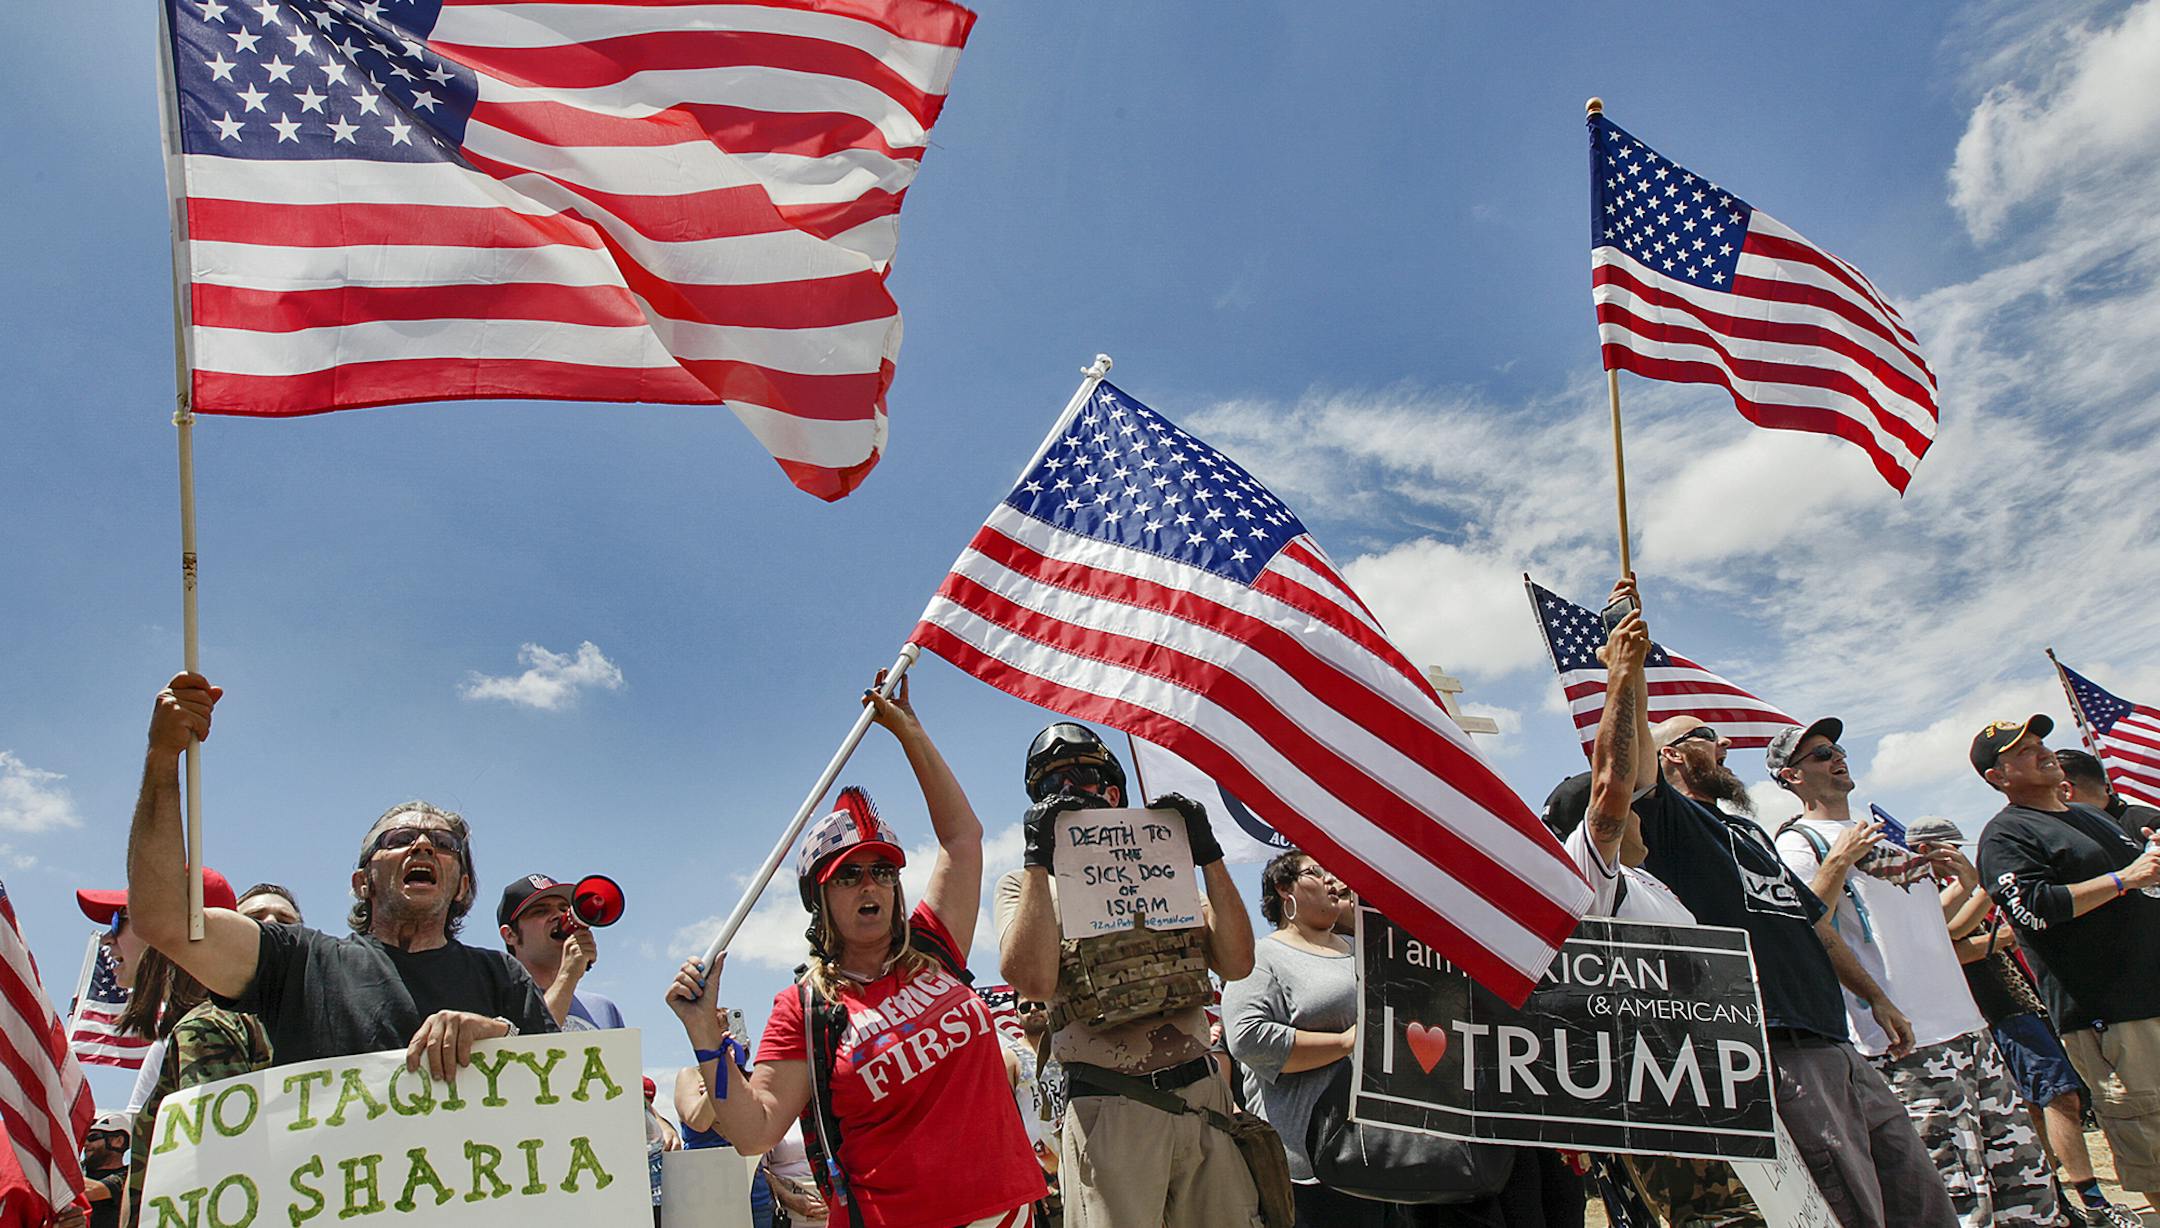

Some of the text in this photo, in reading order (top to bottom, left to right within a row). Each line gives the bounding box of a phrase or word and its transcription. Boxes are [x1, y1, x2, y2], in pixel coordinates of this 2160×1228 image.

[1068, 824, 1171, 847] DEATH TO
[1109, 848, 1142, 862] THE
[1083, 864, 1175, 885] SICK DOG
[1119, 885, 1139, 896] OF
[1106, 897, 1169, 916] ISLAM
[1387, 926, 1394, 959] I
[856, 997, 990, 1102] FIRST
[1451, 1019, 1762, 1109] TRUMP
[153, 1046, 623, 1155] NO TAQIYYA
[147, 1136, 614, 1228] NO SHARIA
